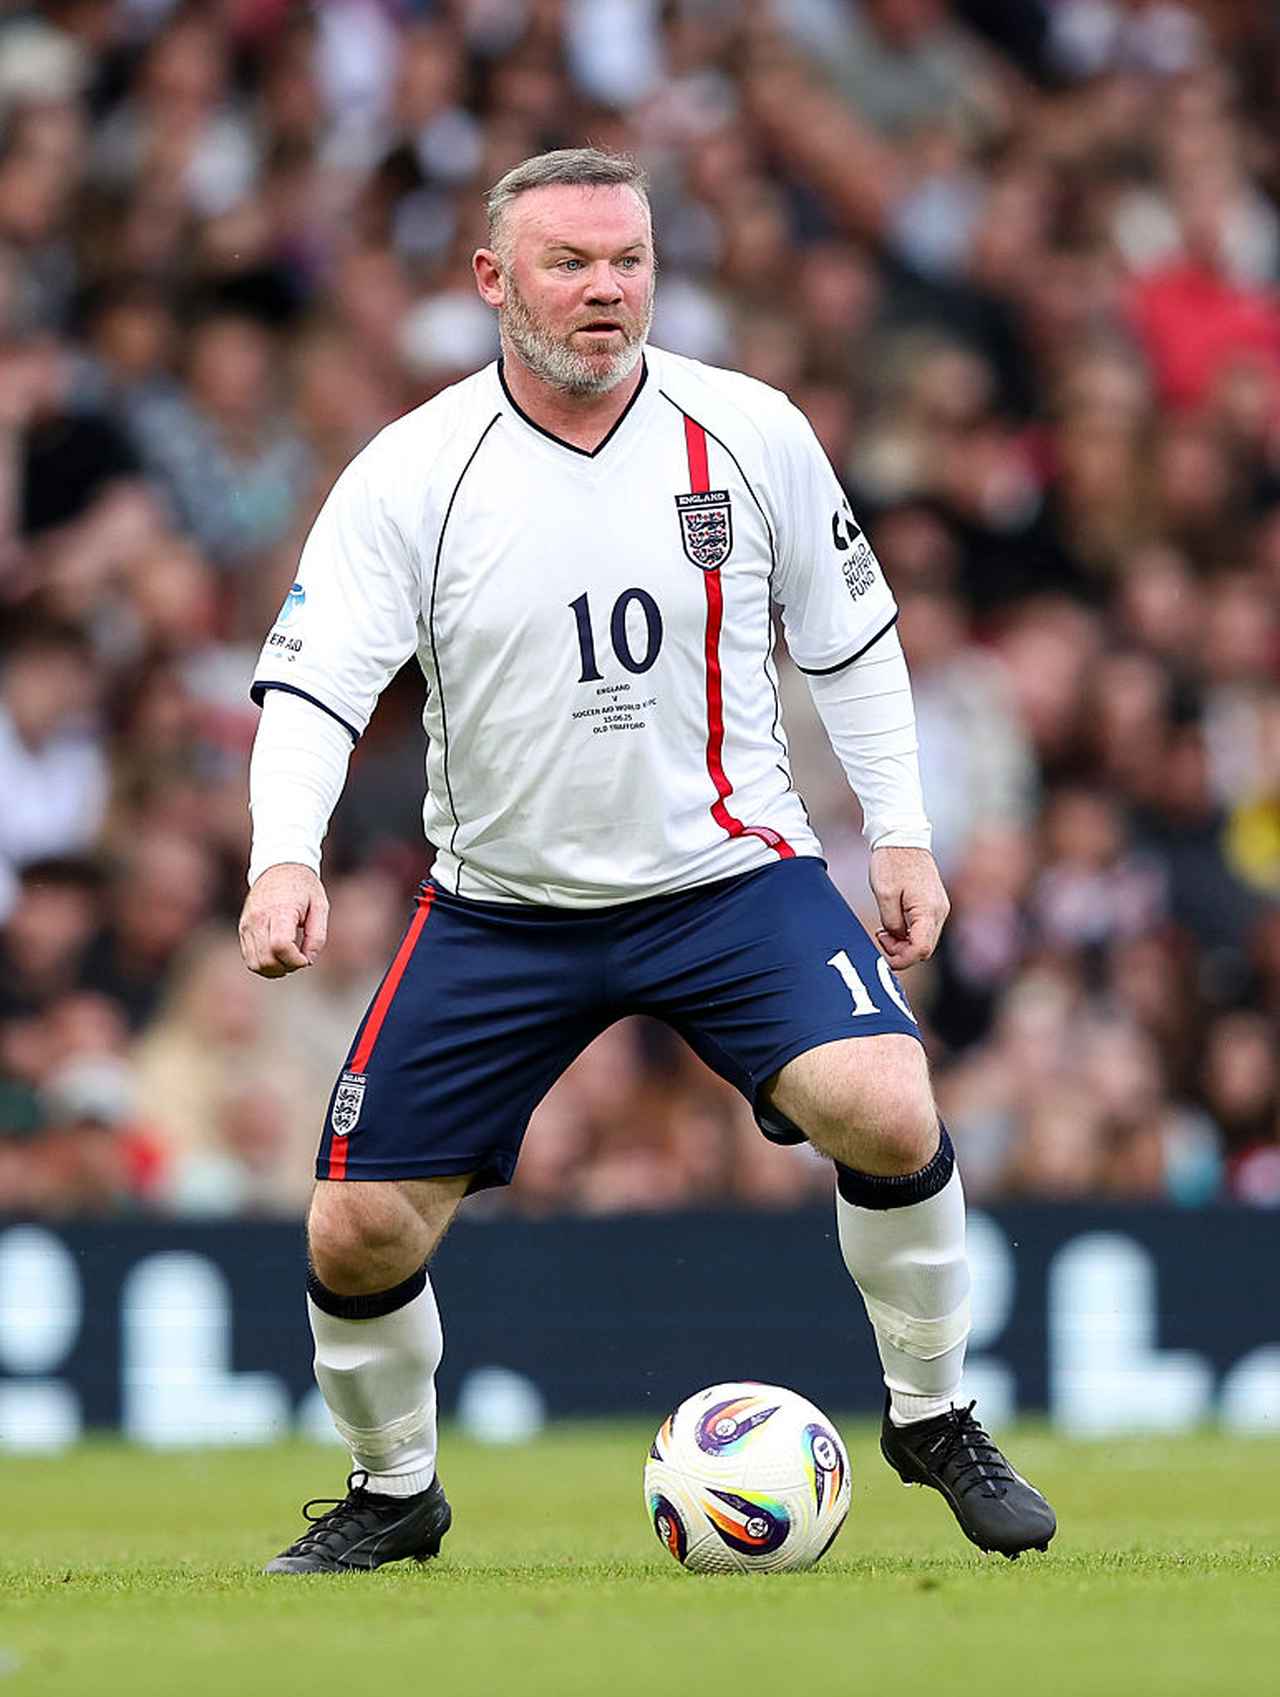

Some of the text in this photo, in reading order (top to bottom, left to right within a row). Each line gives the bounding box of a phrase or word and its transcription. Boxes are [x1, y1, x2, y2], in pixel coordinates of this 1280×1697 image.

[678, 492, 726, 505] ENGLAND
[849, 571, 876, 602] FUND
[568, 587, 663, 683] 10
[596, 684, 631, 695] ENGLAND
[615, 703, 641, 712] WORLD
[593, 721, 646, 734] OLD TRAFFORD
